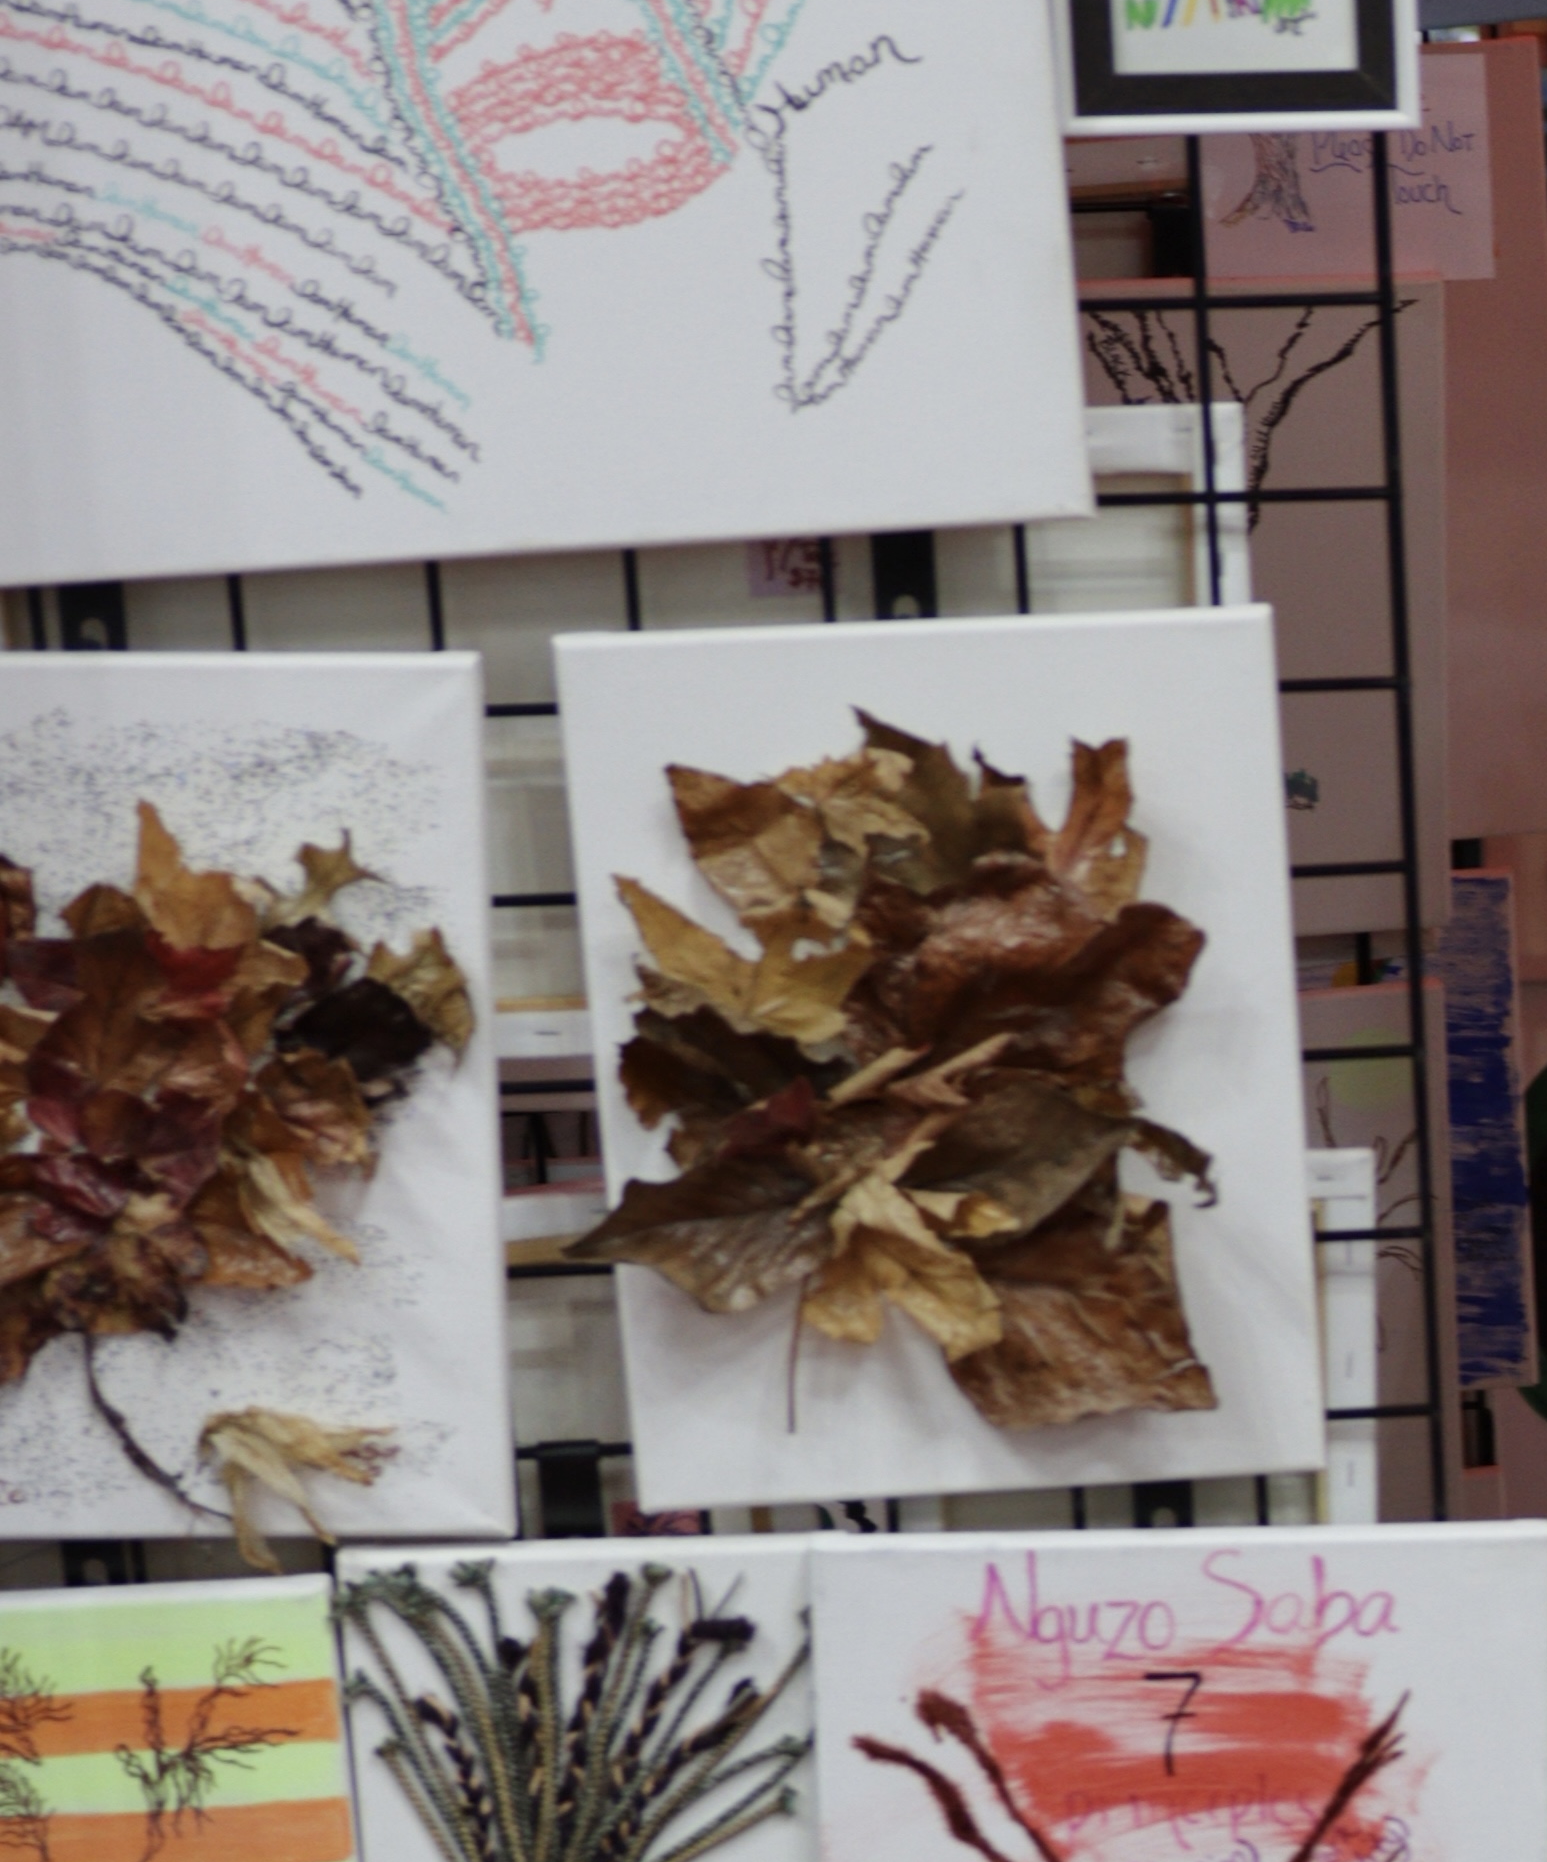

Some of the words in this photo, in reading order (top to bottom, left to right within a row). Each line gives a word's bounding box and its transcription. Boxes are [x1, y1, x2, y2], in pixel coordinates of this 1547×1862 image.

[967, 1552, 1176, 1693] Nguzo
[1199, 1550, 1402, 1651] Saba
[1143, 1671, 1204, 1777] 7
